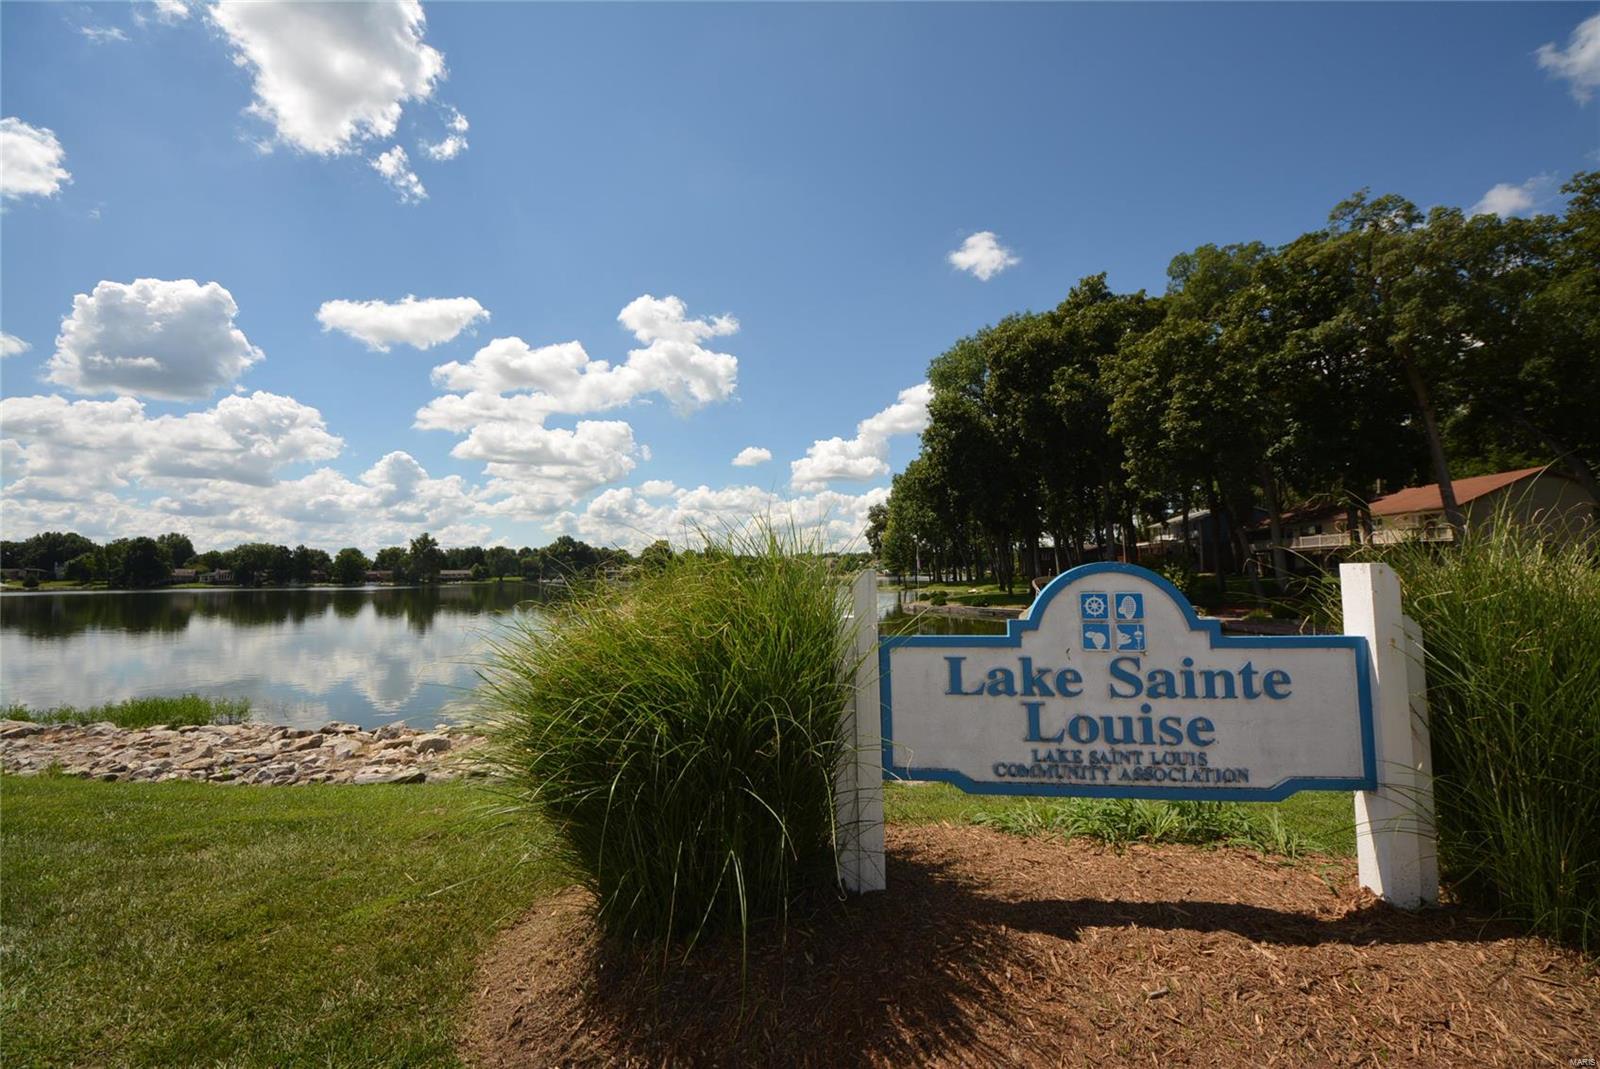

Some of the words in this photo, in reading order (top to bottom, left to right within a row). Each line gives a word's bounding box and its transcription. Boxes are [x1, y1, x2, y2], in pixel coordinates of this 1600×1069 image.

[944, 656, 1083, 698] Lake
[1109, 656, 1293, 700] Sainte
[1023, 701, 1216, 747] Louise
[993, 763, 1114, 783] COMMUNITY
[1121, 766, 1250, 783] ASSOCIATION
[1031, 749, 1083, 765] LAKE
[1088, 749, 1143, 766] SAINT
[1150, 750, 1208, 767] LOUIS
